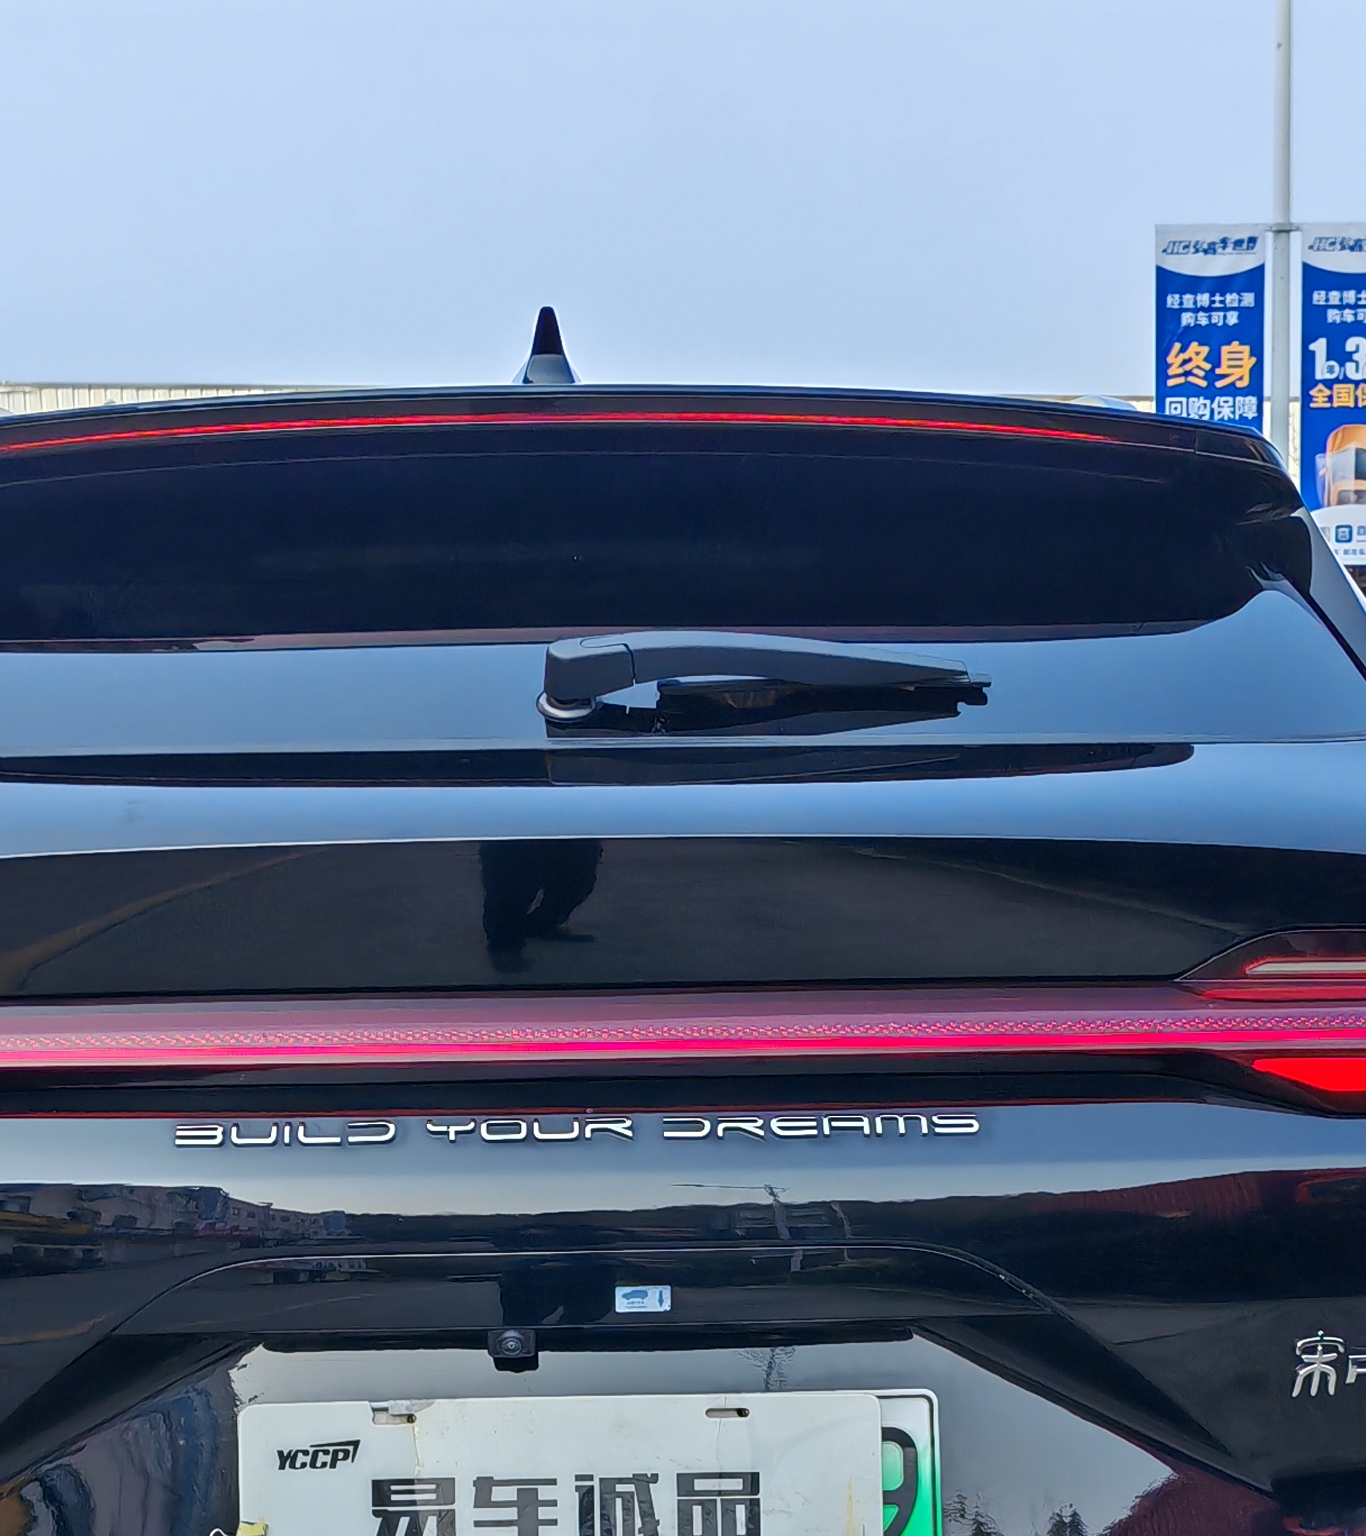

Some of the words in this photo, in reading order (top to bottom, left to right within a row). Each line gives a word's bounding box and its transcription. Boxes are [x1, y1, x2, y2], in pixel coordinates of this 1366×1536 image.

[1181, 310, 1240, 327] 购车可享
[1166, 341, 1257, 388] 终身
[1165, 397, 1258, 420] 回购保障
[174, 1119, 396, 1147] BUILD
[426, 1117, 634, 1143] YOUR
[661, 1113, 980, 1139] DREAMS
[276, 1440, 360, 1471] YCCP
